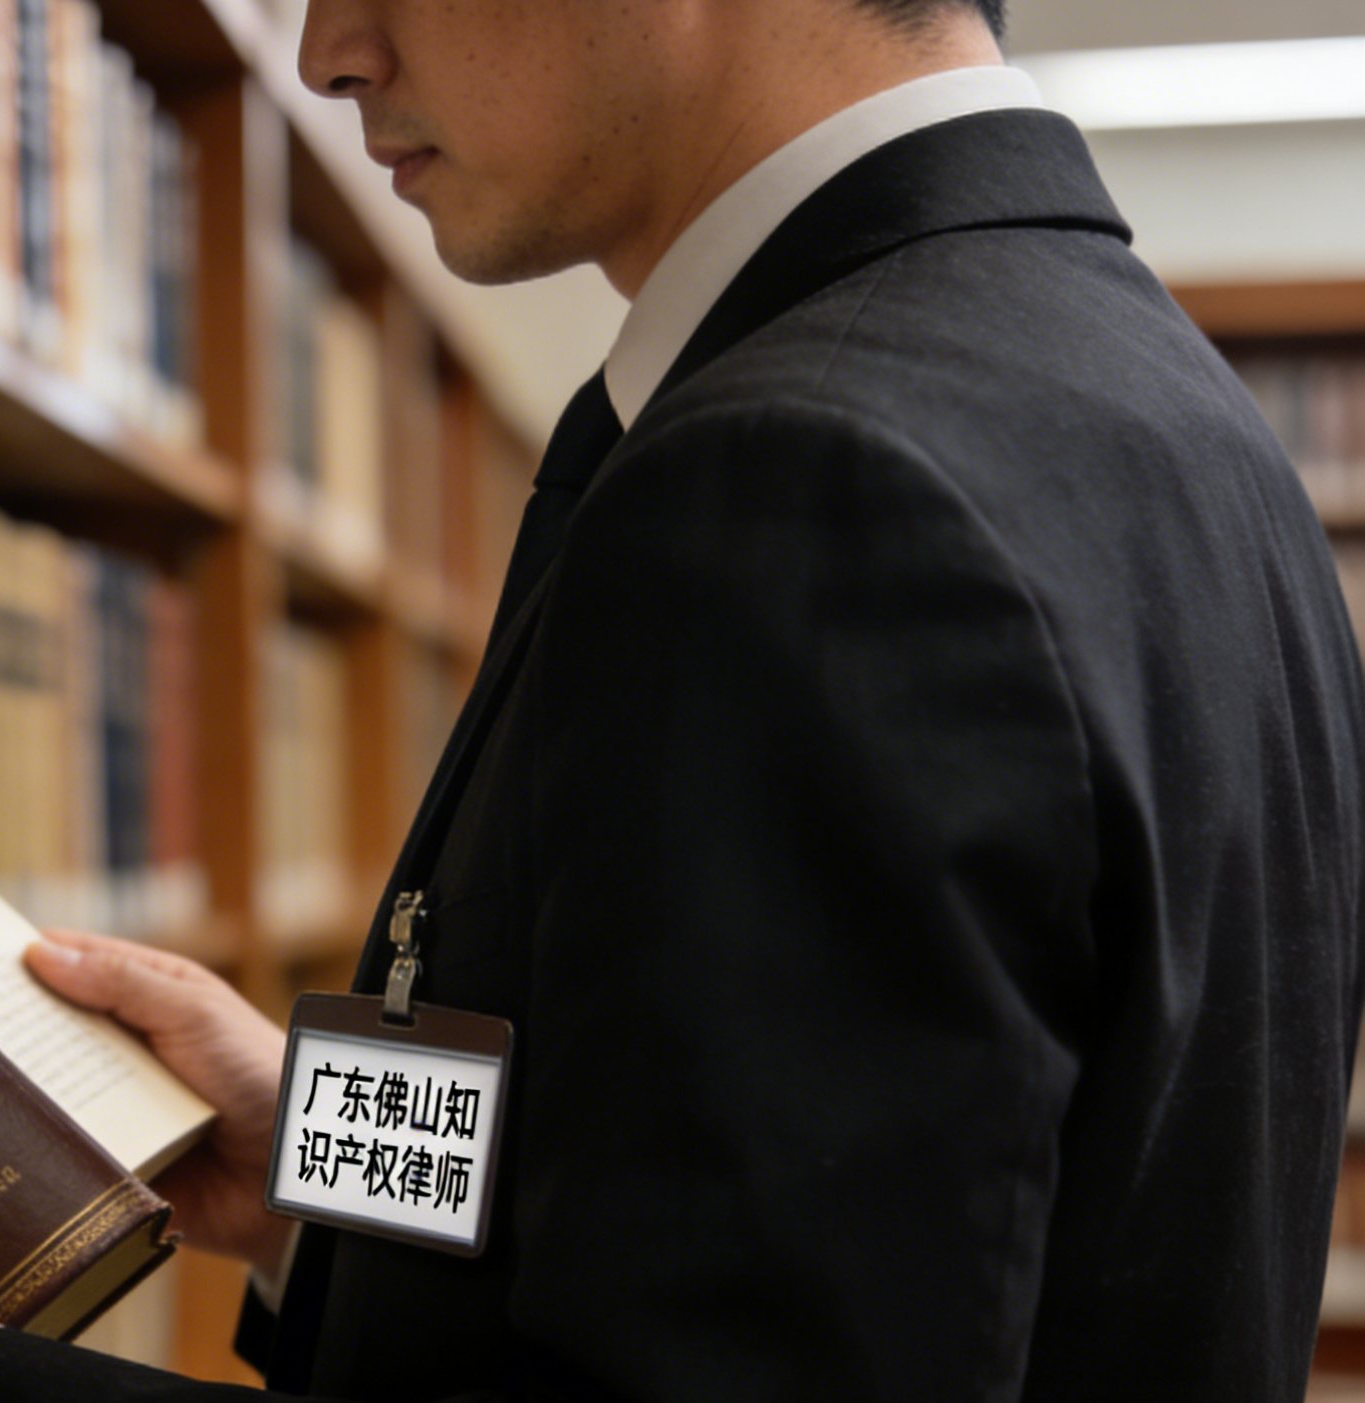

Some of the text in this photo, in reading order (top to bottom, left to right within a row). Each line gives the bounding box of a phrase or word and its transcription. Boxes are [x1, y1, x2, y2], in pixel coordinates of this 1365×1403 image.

[303, 1062, 481, 1140] 广东佛山知
[297, 1127, 473, 1214] 识产权律师
